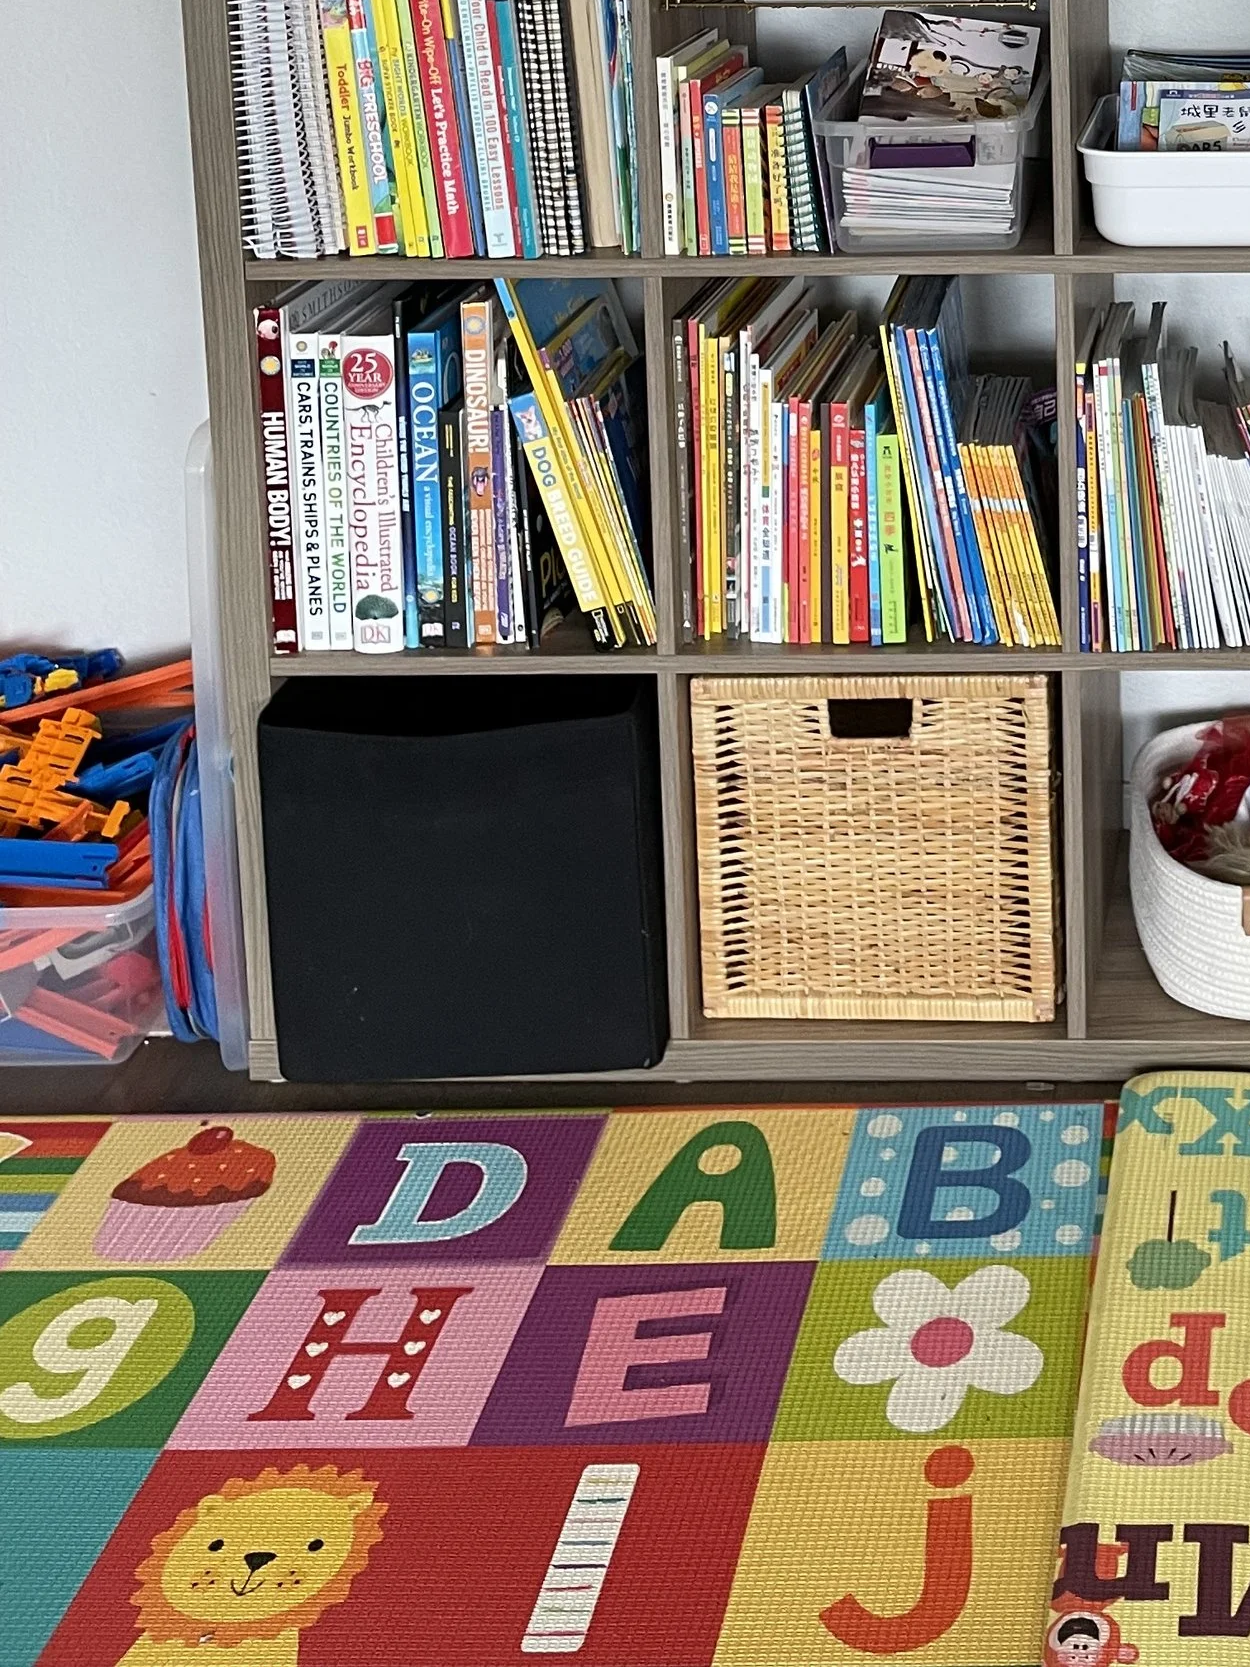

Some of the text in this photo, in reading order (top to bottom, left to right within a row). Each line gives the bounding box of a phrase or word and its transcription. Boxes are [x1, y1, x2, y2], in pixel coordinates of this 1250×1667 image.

[475, 23, 488, 51] Child
[477, 55, 489, 66] to
[479, 70, 493, 96] Read
[336, 63, 360, 190] Toddler Jumbo Workbook
[362, 93, 386, 184] PRESCHOOL
[430, 88, 459, 214] Let's Practice Math
[483, 100, 494, 110] in
[484, 114, 497, 134] 100
[487, 137, 501, 161] Easy
[490, 166, 506, 210] Lessons
[348, 371, 382, 383] YEAR
[351, 353, 378, 374] 25
[465, 350, 489, 453] DINOSAUR!
[261, 412, 291, 545] HUMAN BODY!
[411, 382, 438, 482] OCEAN
[297, 383, 323, 615] CARS, TRAINS, SHIPS & PLANES
[324, 383, 346, 613] COUNTRIES OF THE WORLD
[348, 423, 377, 591] Encyclopedia
[374, 423, 397, 592] Children's Illustrated
[532, 447, 598, 603] DOG BREED GUIDE
[347, 1141, 527, 1246] D
[609, 1120, 777, 1251] A
[896, 1124, 1032, 1240] B
[0, 1297, 159, 1424] g
[247, 1285, 475, 1422] H
[564, 1285, 726, 1427] E
[818, 1445, 974, 1655] j
